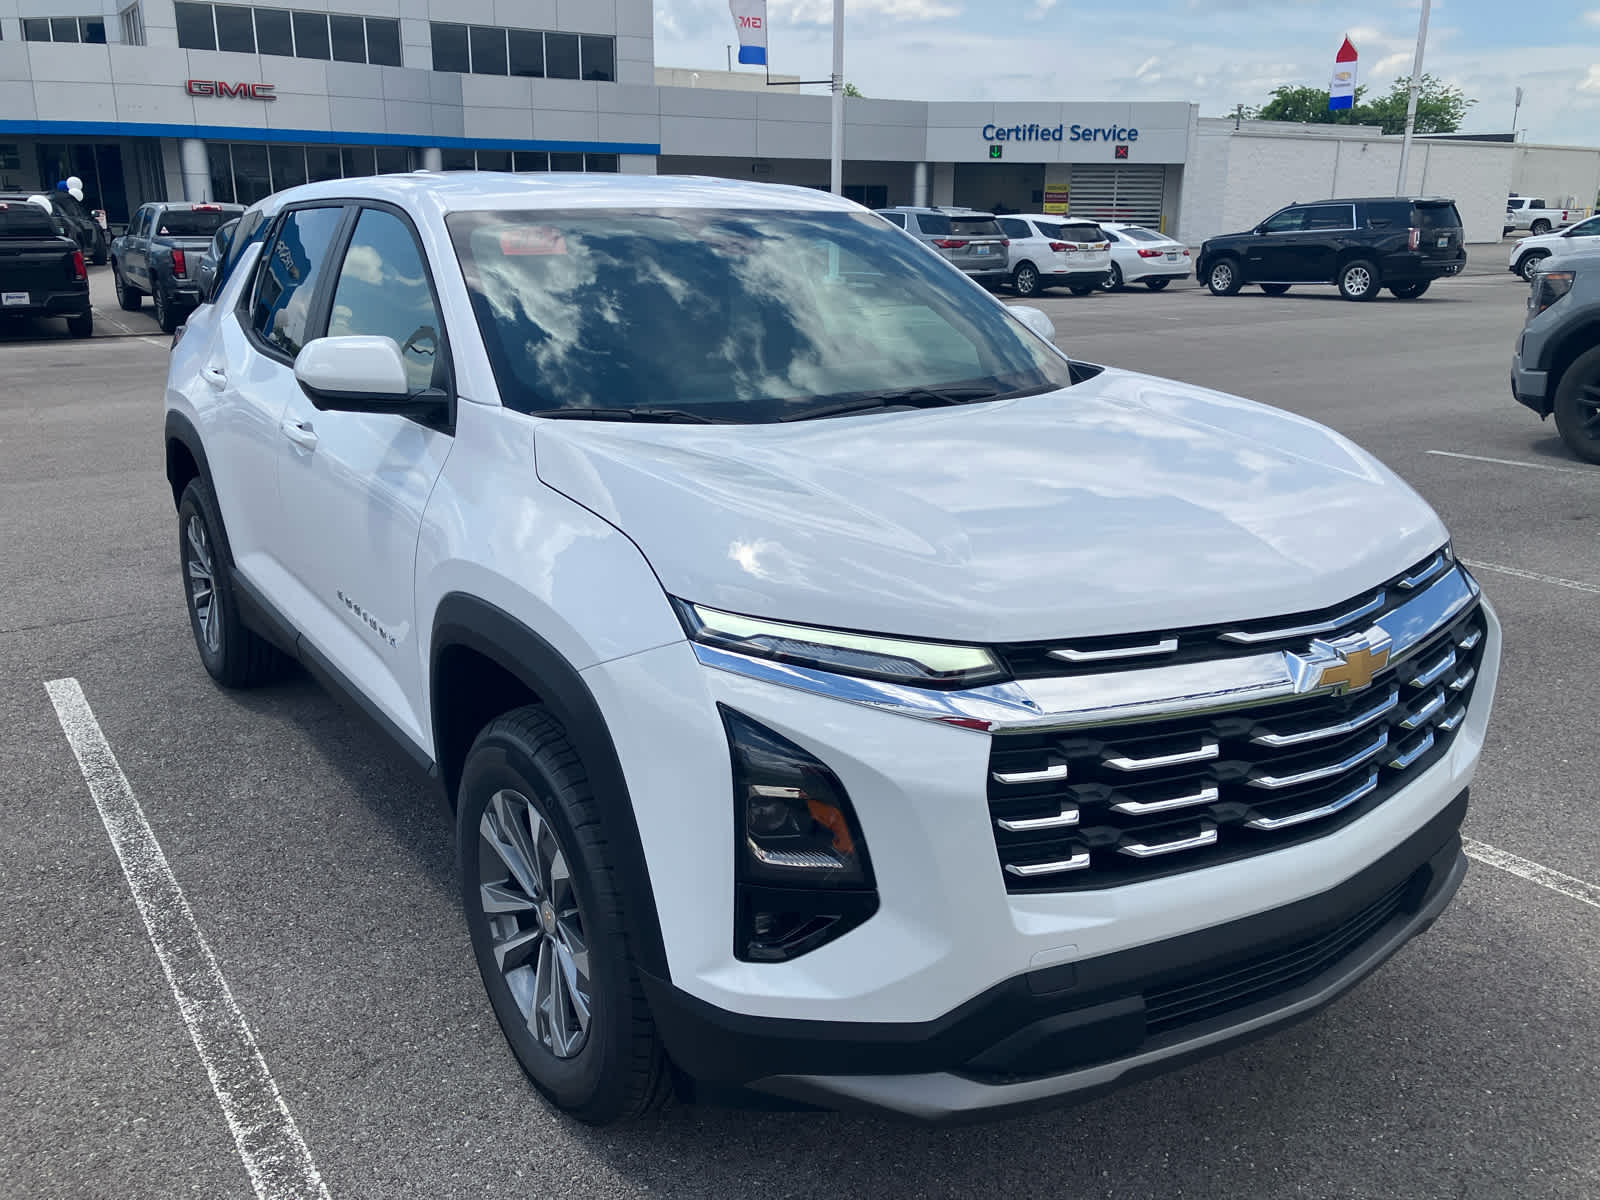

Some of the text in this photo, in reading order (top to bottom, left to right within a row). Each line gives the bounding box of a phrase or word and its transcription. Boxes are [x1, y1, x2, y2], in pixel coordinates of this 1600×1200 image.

[185, 79, 277, 100] GMC
[982, 124, 1139, 142] Certified Service
